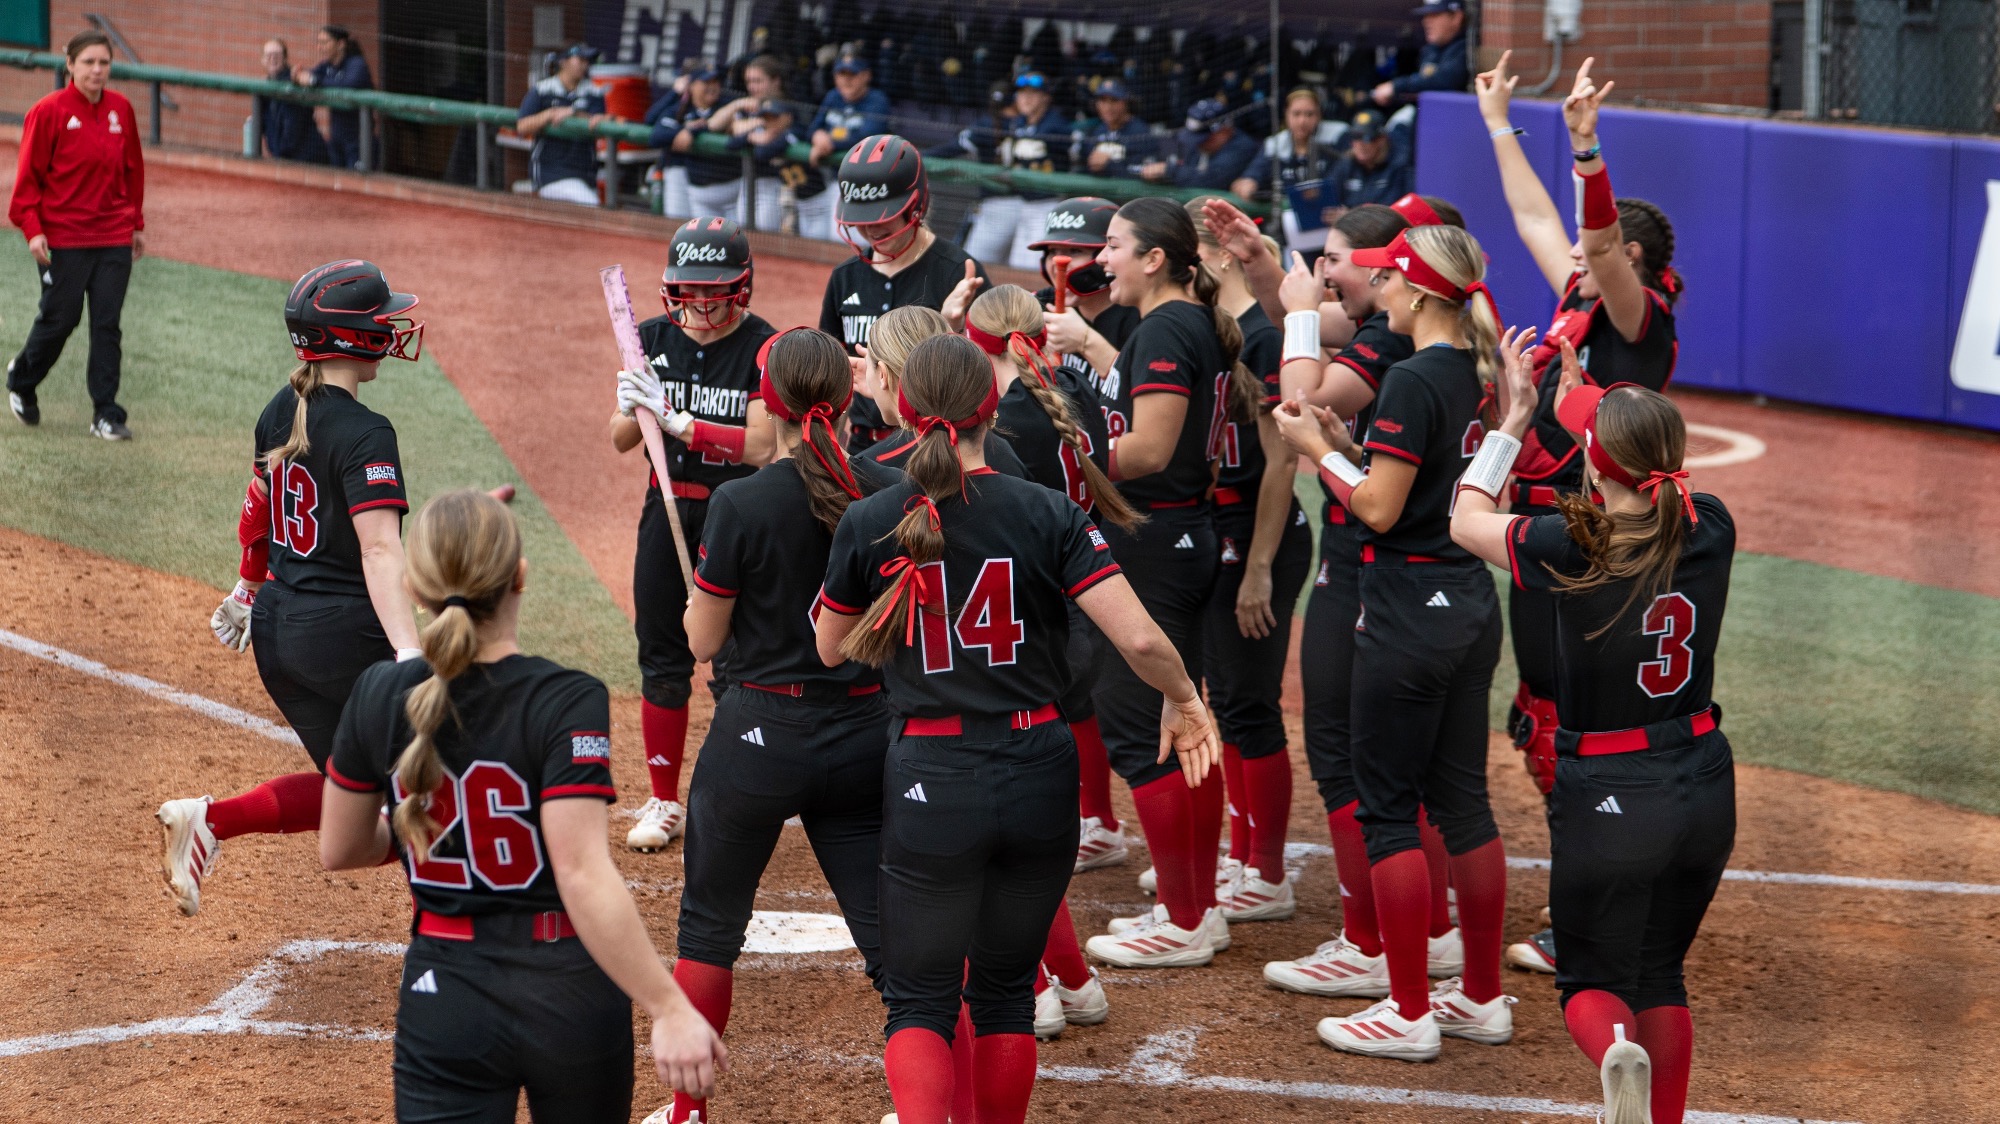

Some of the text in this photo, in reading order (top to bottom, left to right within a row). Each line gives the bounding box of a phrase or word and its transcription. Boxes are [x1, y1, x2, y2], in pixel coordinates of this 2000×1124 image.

[840, 180, 889, 204] Yotes
[676, 241, 727, 266] Yotes
[690, 383, 748, 417] DAKOTA
[366, 465, 395, 475] SOUTH
[367, 472, 396, 481] DAKOTA
[268, 455, 318, 557] 13
[917, 557, 1024, 674] 14
[1637, 592, 1696, 698] 3
[391, 759, 544, 891] 26
